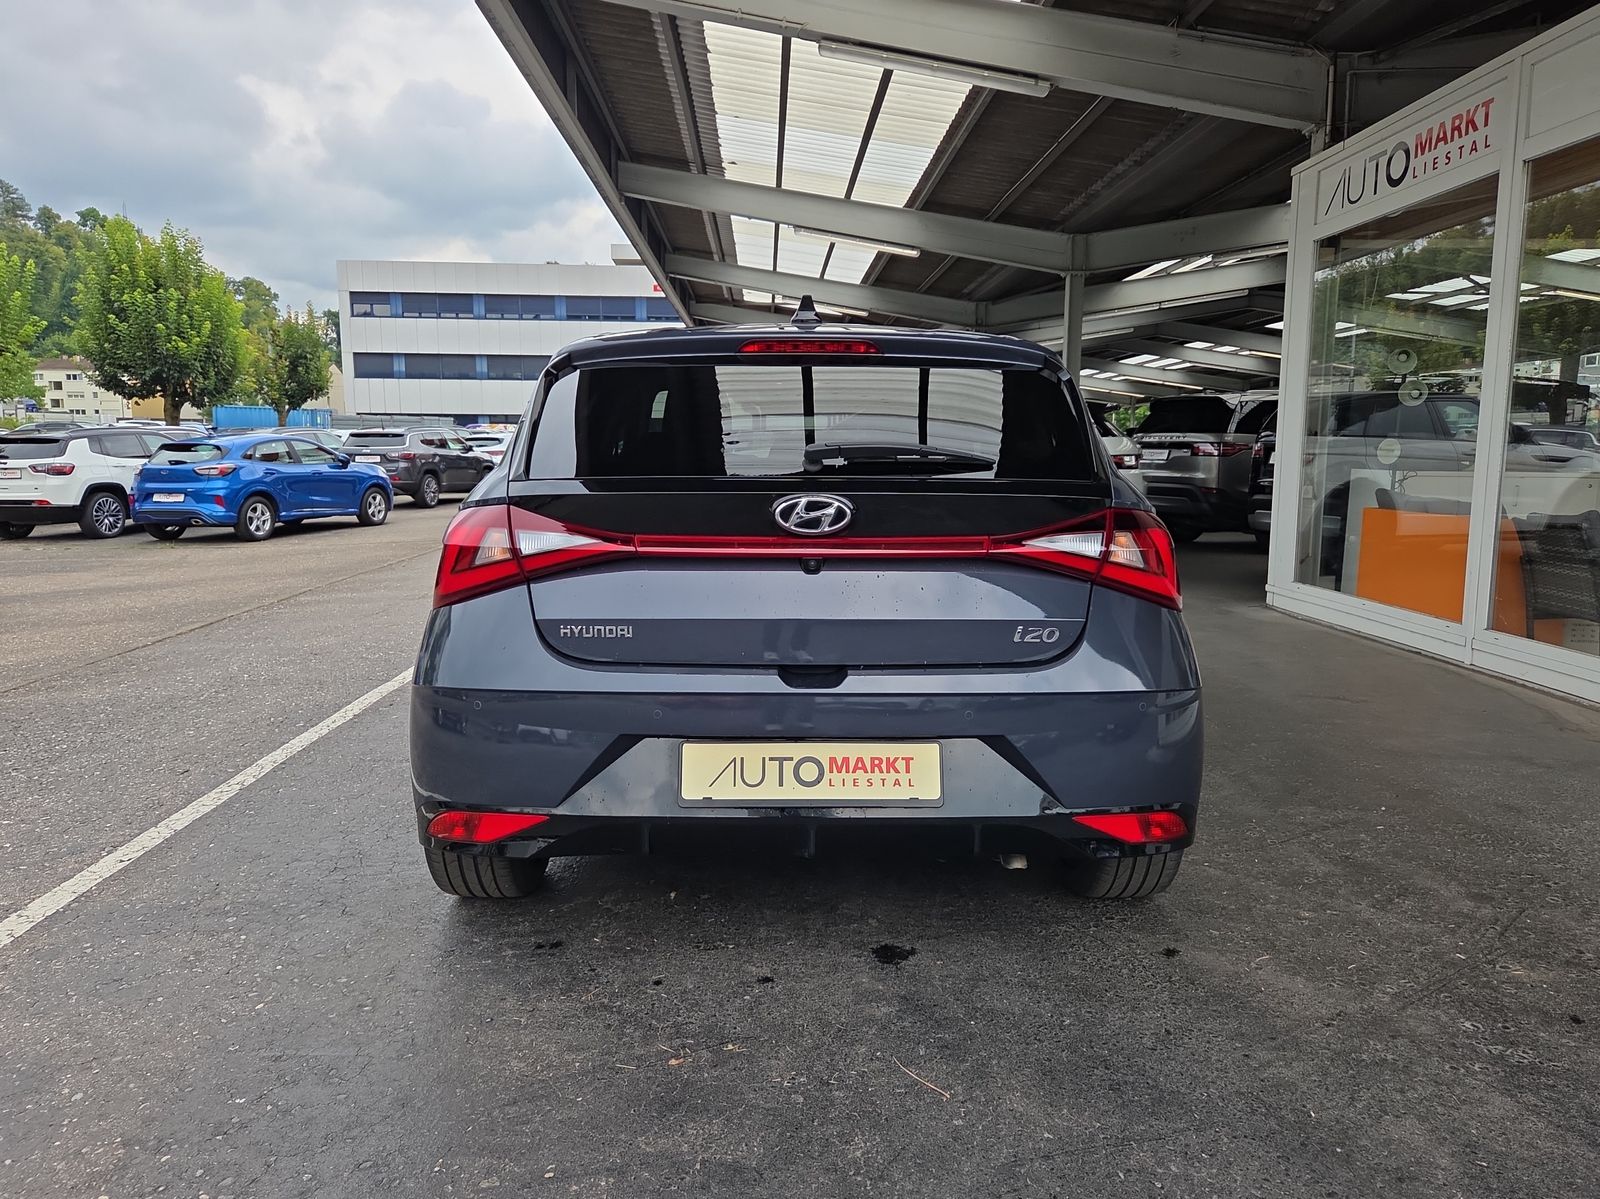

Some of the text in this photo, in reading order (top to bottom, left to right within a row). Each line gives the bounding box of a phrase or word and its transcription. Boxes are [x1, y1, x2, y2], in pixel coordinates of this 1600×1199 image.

[1324, 97, 1495, 216] AUTO MARKT
[1412, 134, 1491, 180] LIESTAL
[560, 625, 633, 638] HYUNDAI
[1013, 625, 1060, 643] i20
[708, 755, 915, 788] AUTO MARKT
[828, 777, 915, 788] LIESTAL
